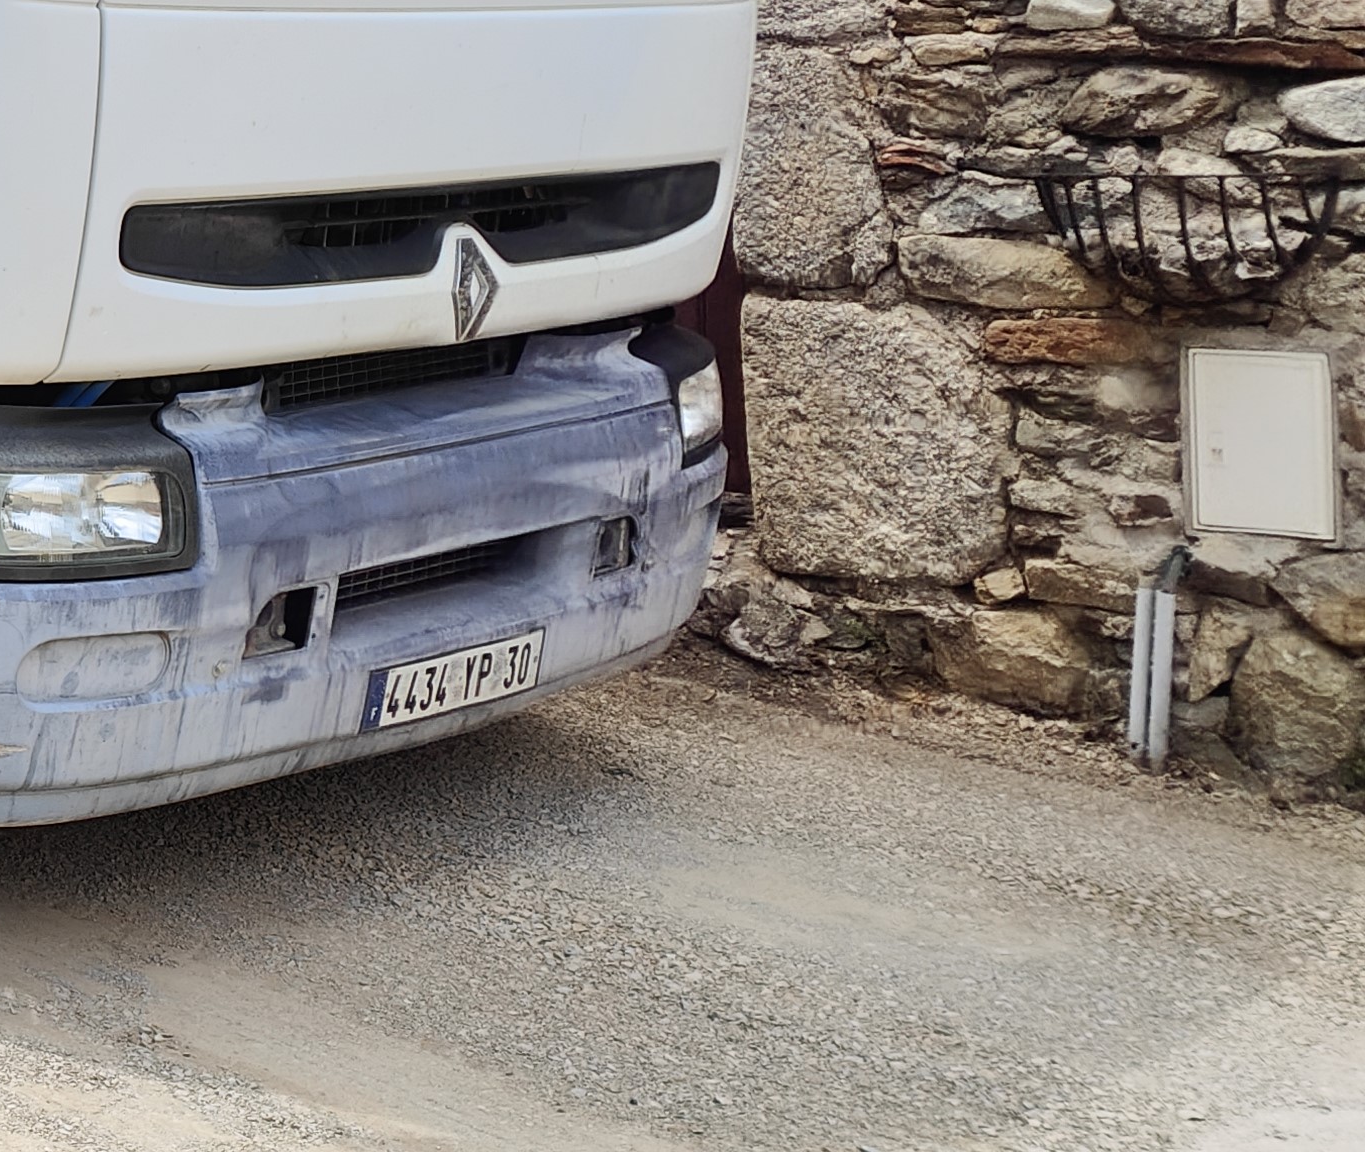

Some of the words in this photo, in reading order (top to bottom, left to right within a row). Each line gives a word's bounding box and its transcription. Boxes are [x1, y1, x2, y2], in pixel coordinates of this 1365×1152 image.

[386, 662, 449, 718] 4434
[463, 652, 493, 701] YP
[503, 642, 532, 689] 30
[370, 707, 378, 721] F
